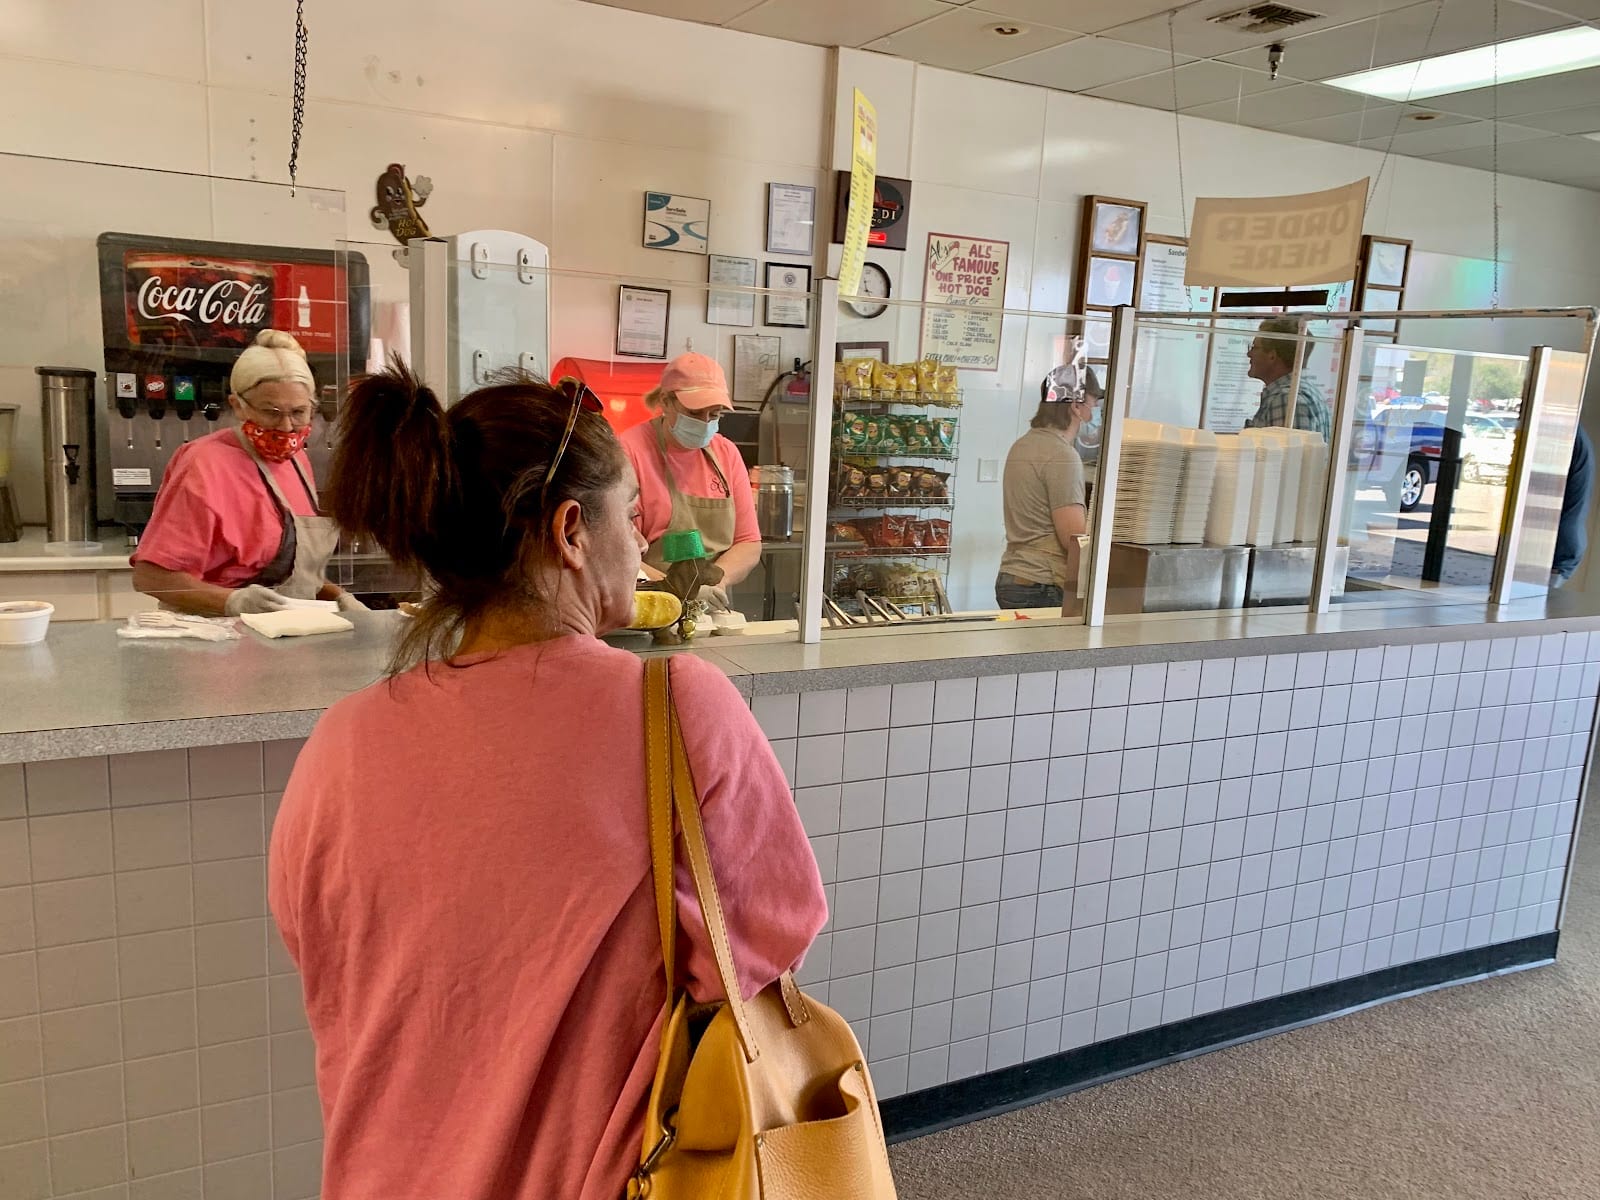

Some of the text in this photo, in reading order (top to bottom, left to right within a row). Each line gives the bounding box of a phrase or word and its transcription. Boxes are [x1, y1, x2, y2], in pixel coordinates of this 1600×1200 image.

[952, 256, 999, 275] FAMOUS
[938, 282, 989, 297] HOT DOG
[137, 275, 269, 324] Coca-Cola
